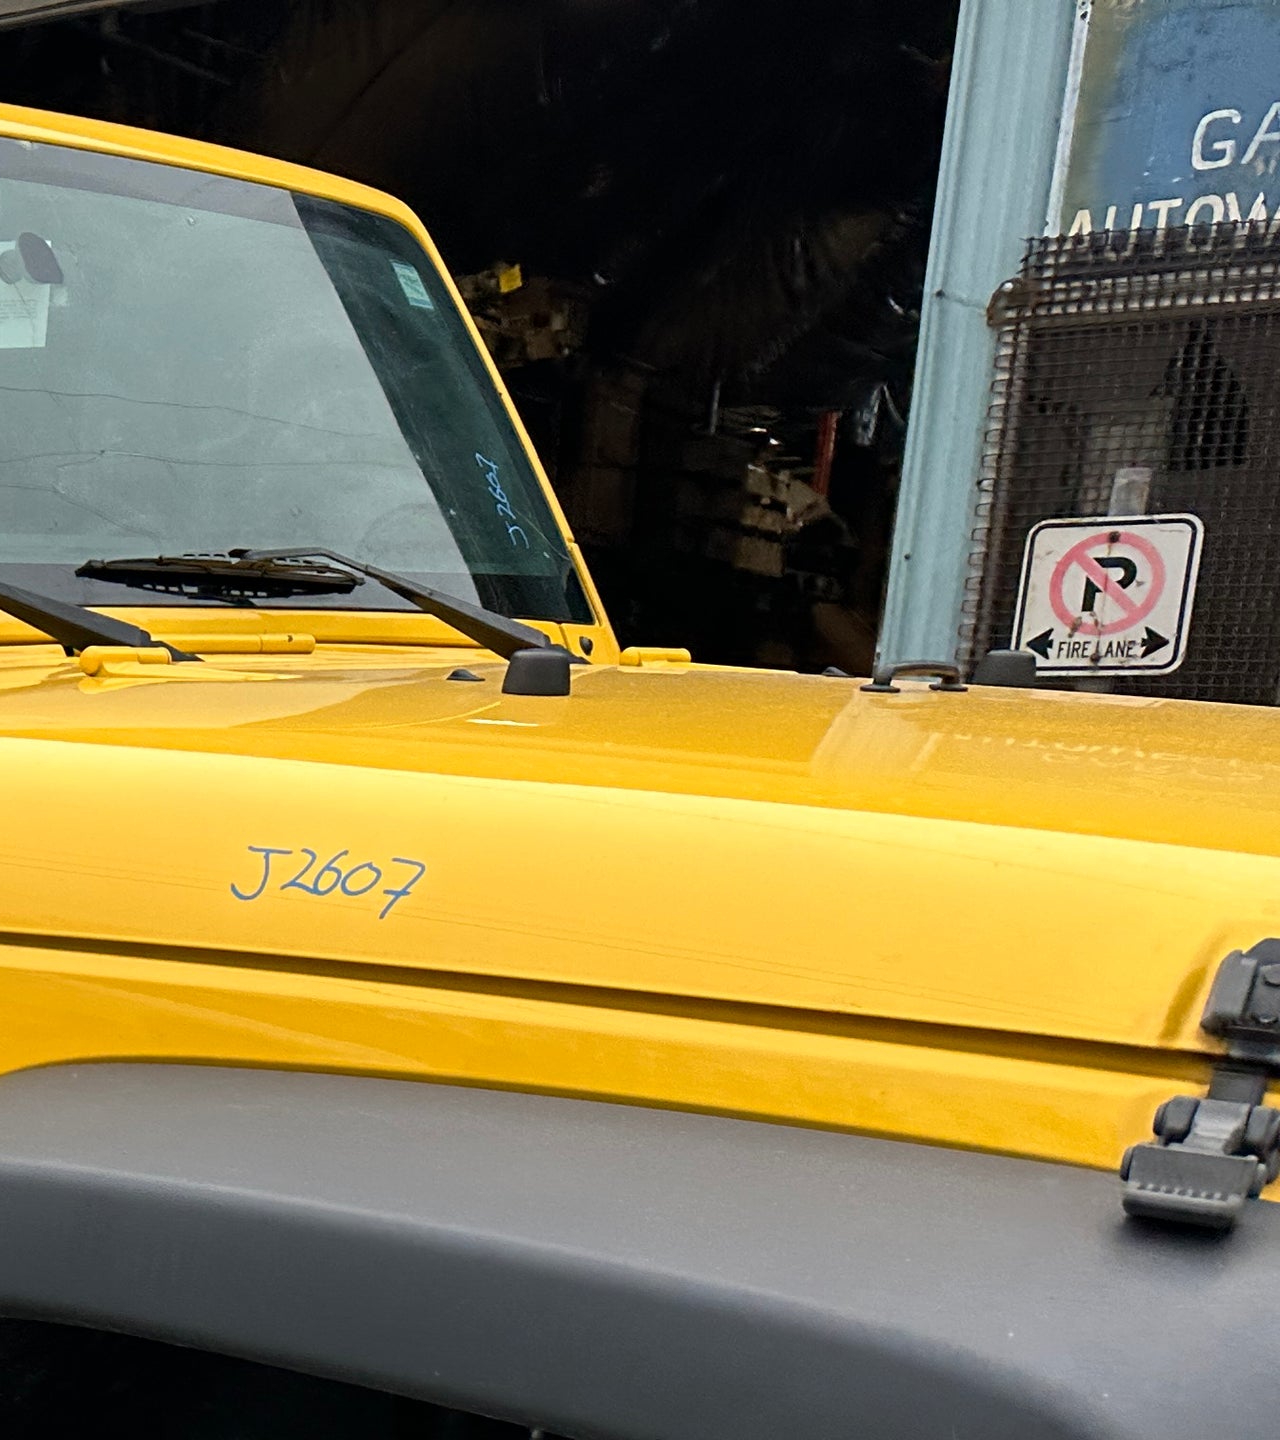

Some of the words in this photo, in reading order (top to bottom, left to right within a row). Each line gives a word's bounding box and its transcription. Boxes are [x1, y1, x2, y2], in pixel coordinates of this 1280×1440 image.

[474, 452, 530, 549] J2607
[1056, 641, 1092, 660] FIRE
[1095, 640, 1139, 659] LANE
[230, 845, 426, 920] J2607
